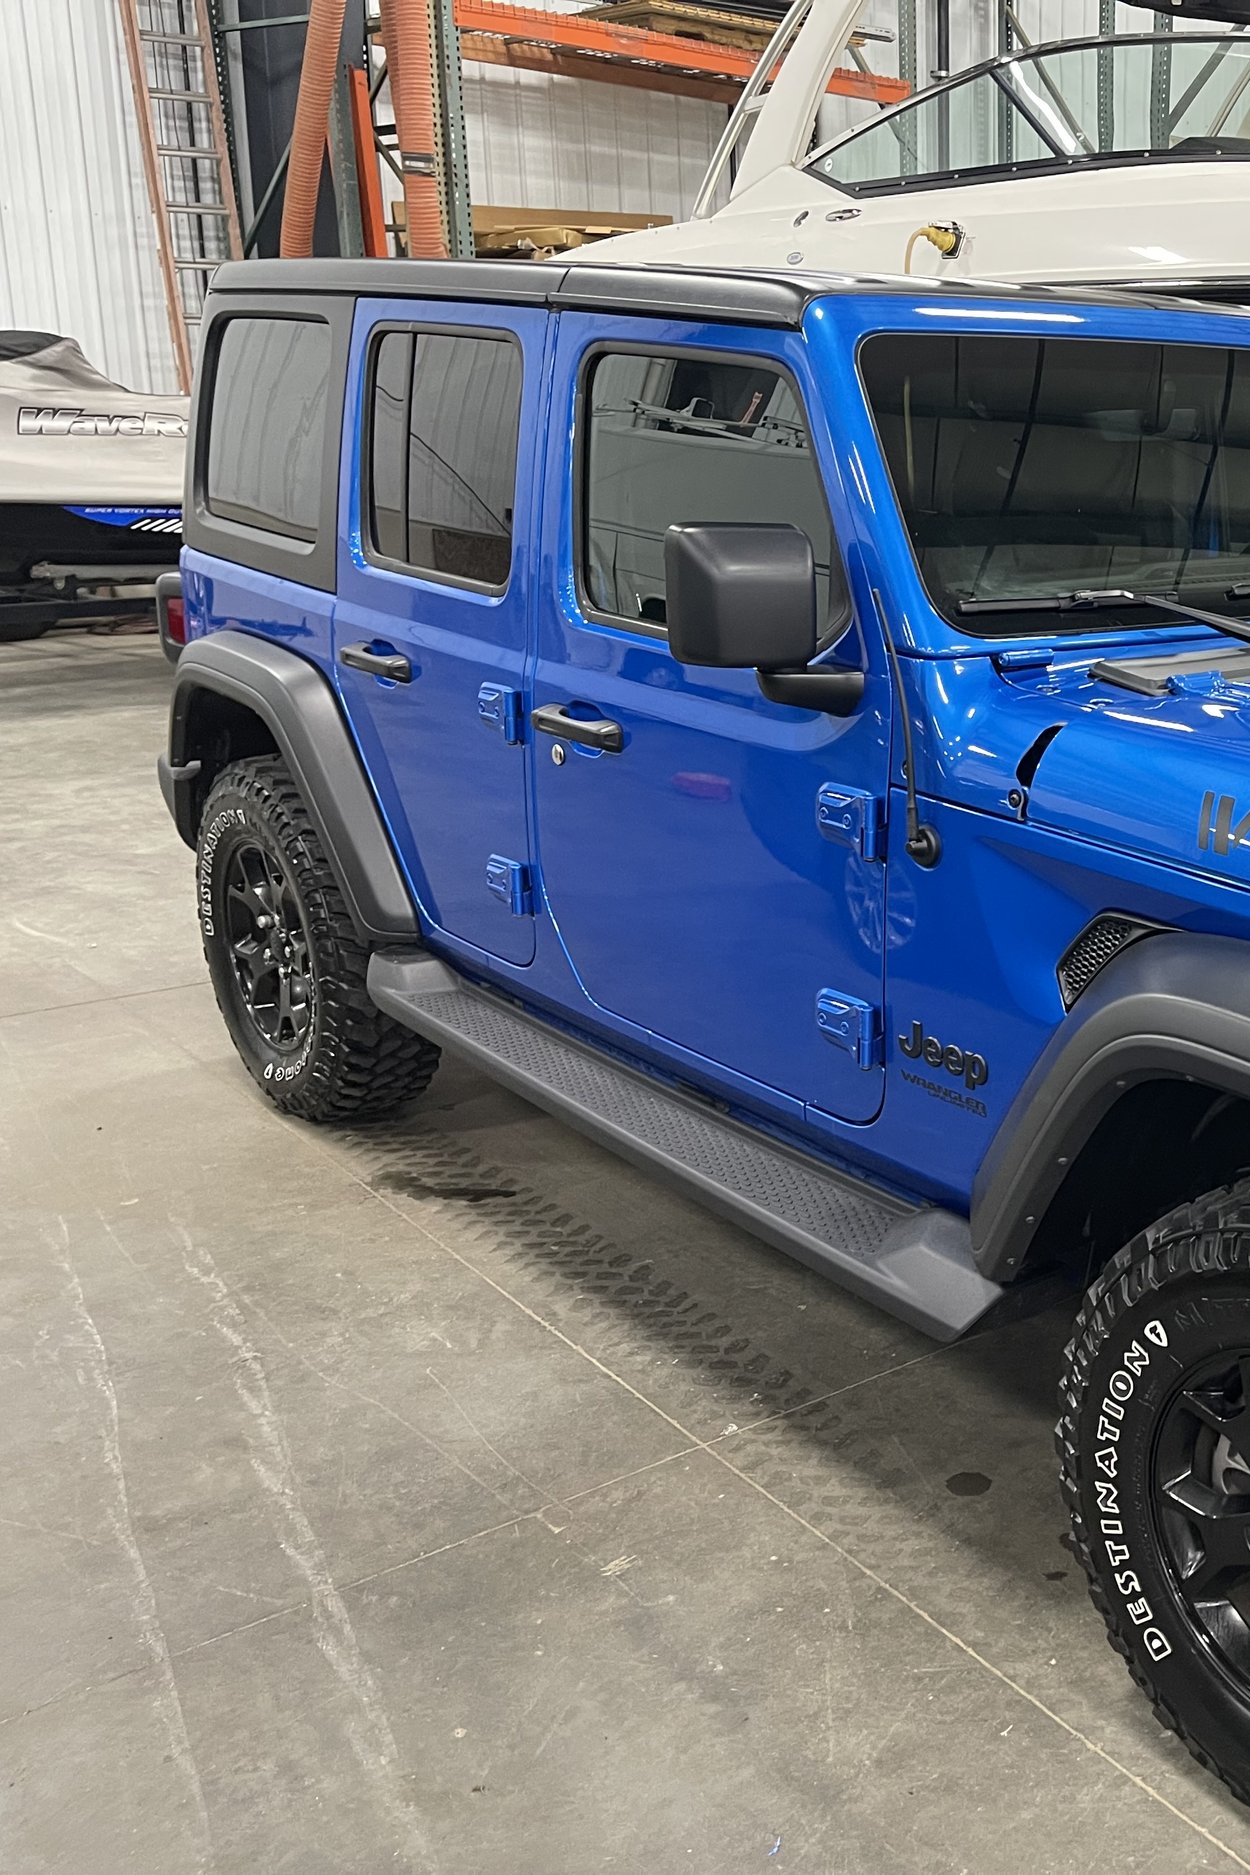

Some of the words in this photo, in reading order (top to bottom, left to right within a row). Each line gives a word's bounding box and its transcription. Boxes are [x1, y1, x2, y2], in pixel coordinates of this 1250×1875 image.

[17, 406, 190, 437] WaveR
[200, 808, 238, 936] DESTINATION
[898, 1020, 988, 1091] Jeep
[901, 1068, 987, 1112] WRANGLER
[1094, 1339, 1173, 1662] DESTINATION
